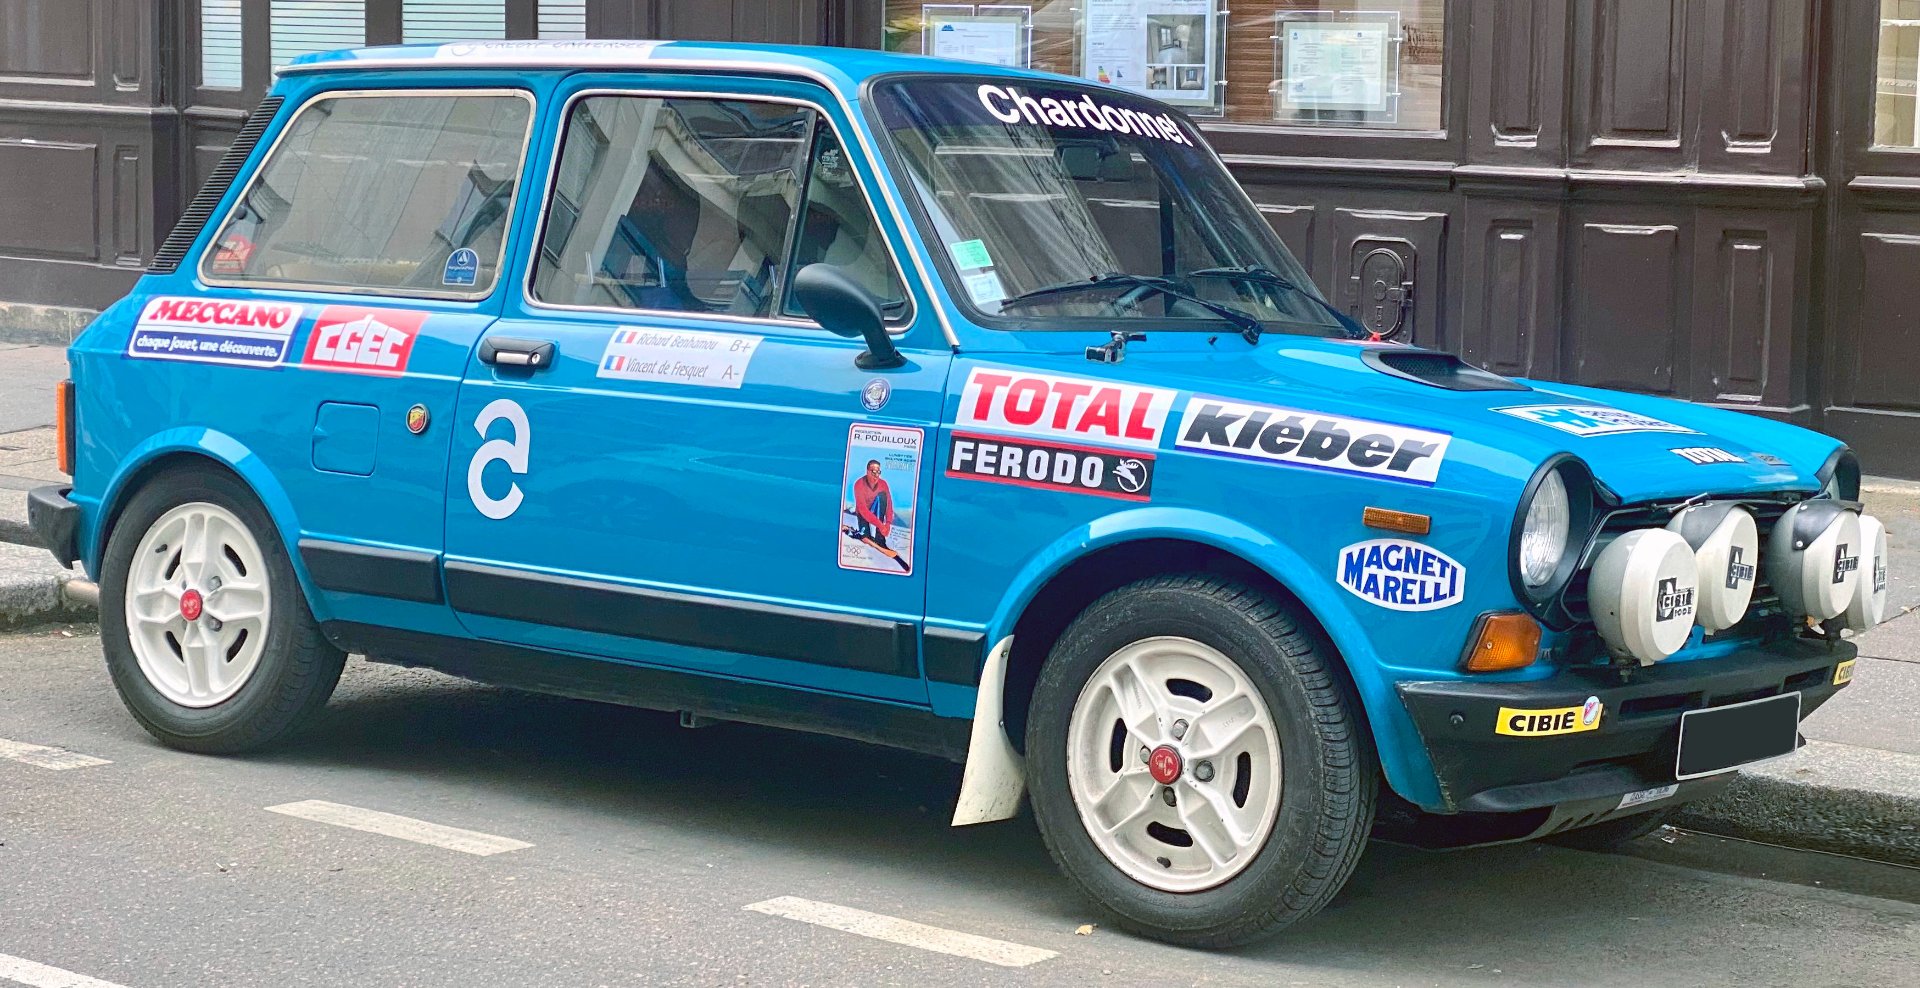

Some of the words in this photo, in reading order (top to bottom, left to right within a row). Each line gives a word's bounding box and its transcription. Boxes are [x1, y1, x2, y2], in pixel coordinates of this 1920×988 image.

[977, 84, 1194, 147] Chardonnet
[148, 299, 292, 328] MECCANO
[136, 335, 170, 350] chaque
[169, 336, 198, 351] jouet,
[200, 340, 218, 351] une
[219, 340, 278, 357] découverte.
[636, 333, 670, 347] Richard
[671, 335, 719, 351] Benhamou
[729, 339, 751, 352] B+
[625, 357, 657, 374] Vincent
[658, 361, 669, 375] de
[671, 362, 708, 381] Fresquet
[721, 365, 739, 380] A-
[973, 372, 1156, 441] TOTAL
[865, 434, 917, 445] POUILLOUX
[1183, 403, 1441, 473] kléber
[951, 440, 1104, 488] FERODO
[1343, 544, 1457, 583] MAGNETI
[1343, 570, 1457, 605] MARELLI
